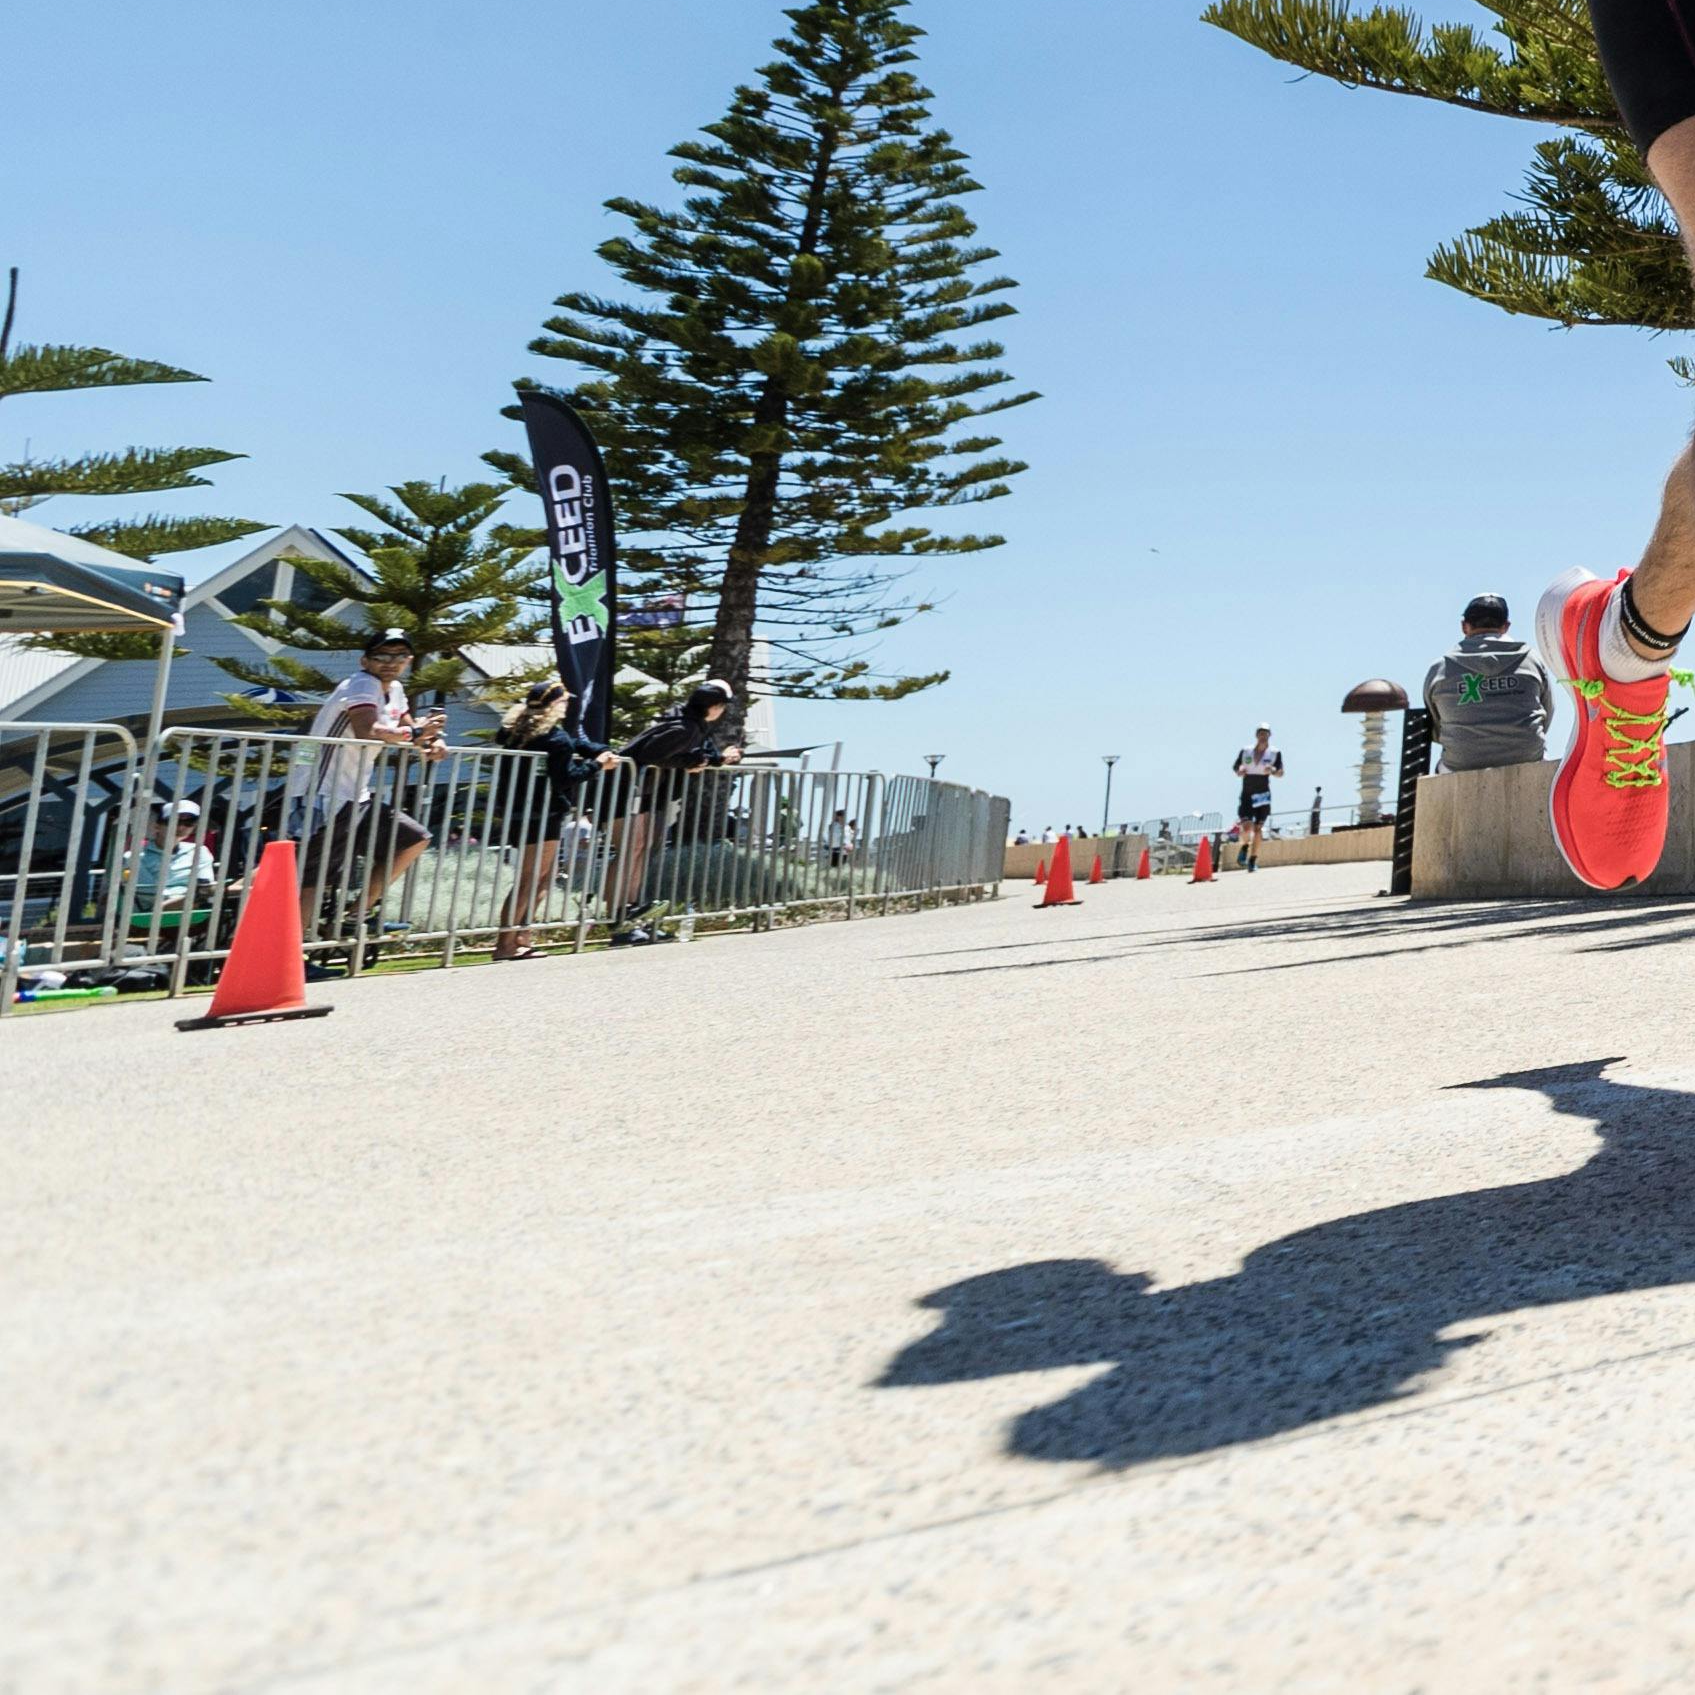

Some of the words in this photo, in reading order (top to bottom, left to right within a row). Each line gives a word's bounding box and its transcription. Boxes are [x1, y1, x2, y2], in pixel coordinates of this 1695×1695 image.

[582, 474, 595, 507] Club
[550, 464, 609, 645] EXCEED
[586, 512, 599, 574] Triathlon
[1458, 672, 1518, 705] EXCEED
